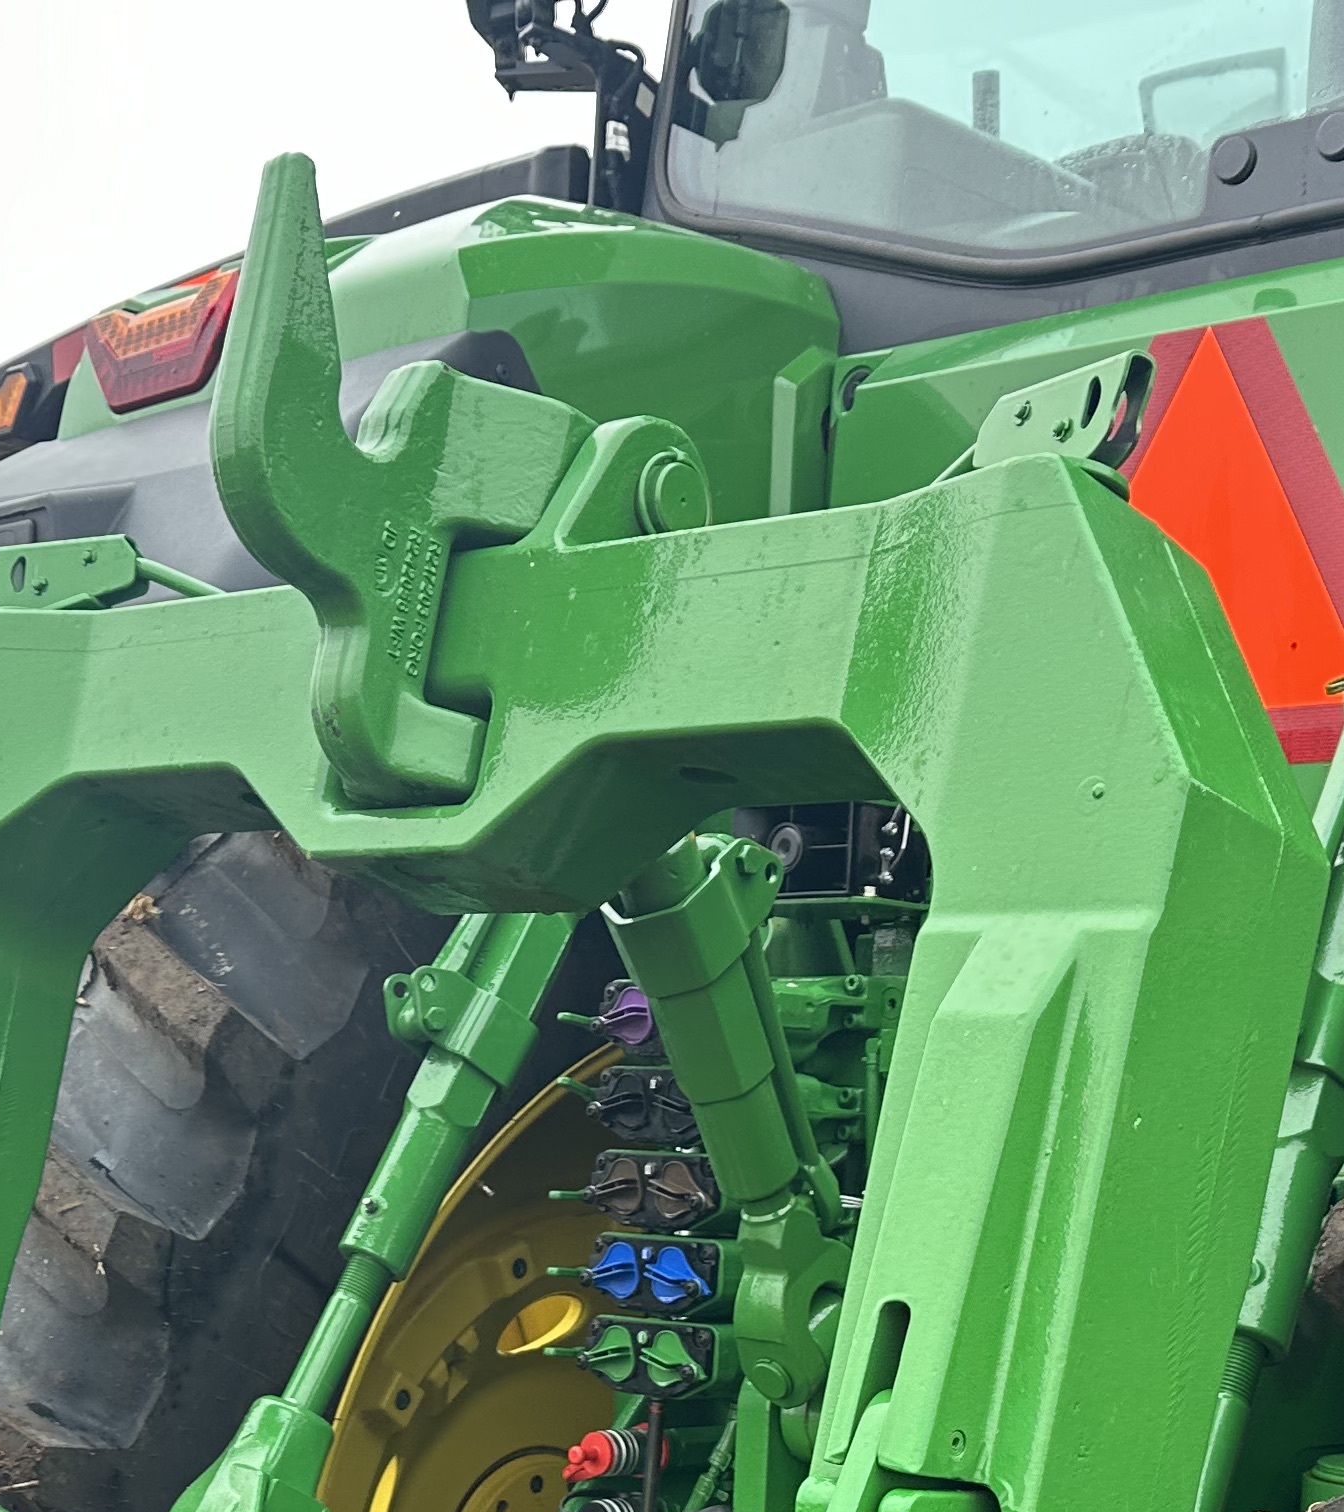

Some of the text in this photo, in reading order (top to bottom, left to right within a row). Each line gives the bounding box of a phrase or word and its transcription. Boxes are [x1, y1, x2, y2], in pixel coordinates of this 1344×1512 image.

[381, 520, 398, 550] JD
[406, 537, 443, 678] R217203 FORG
